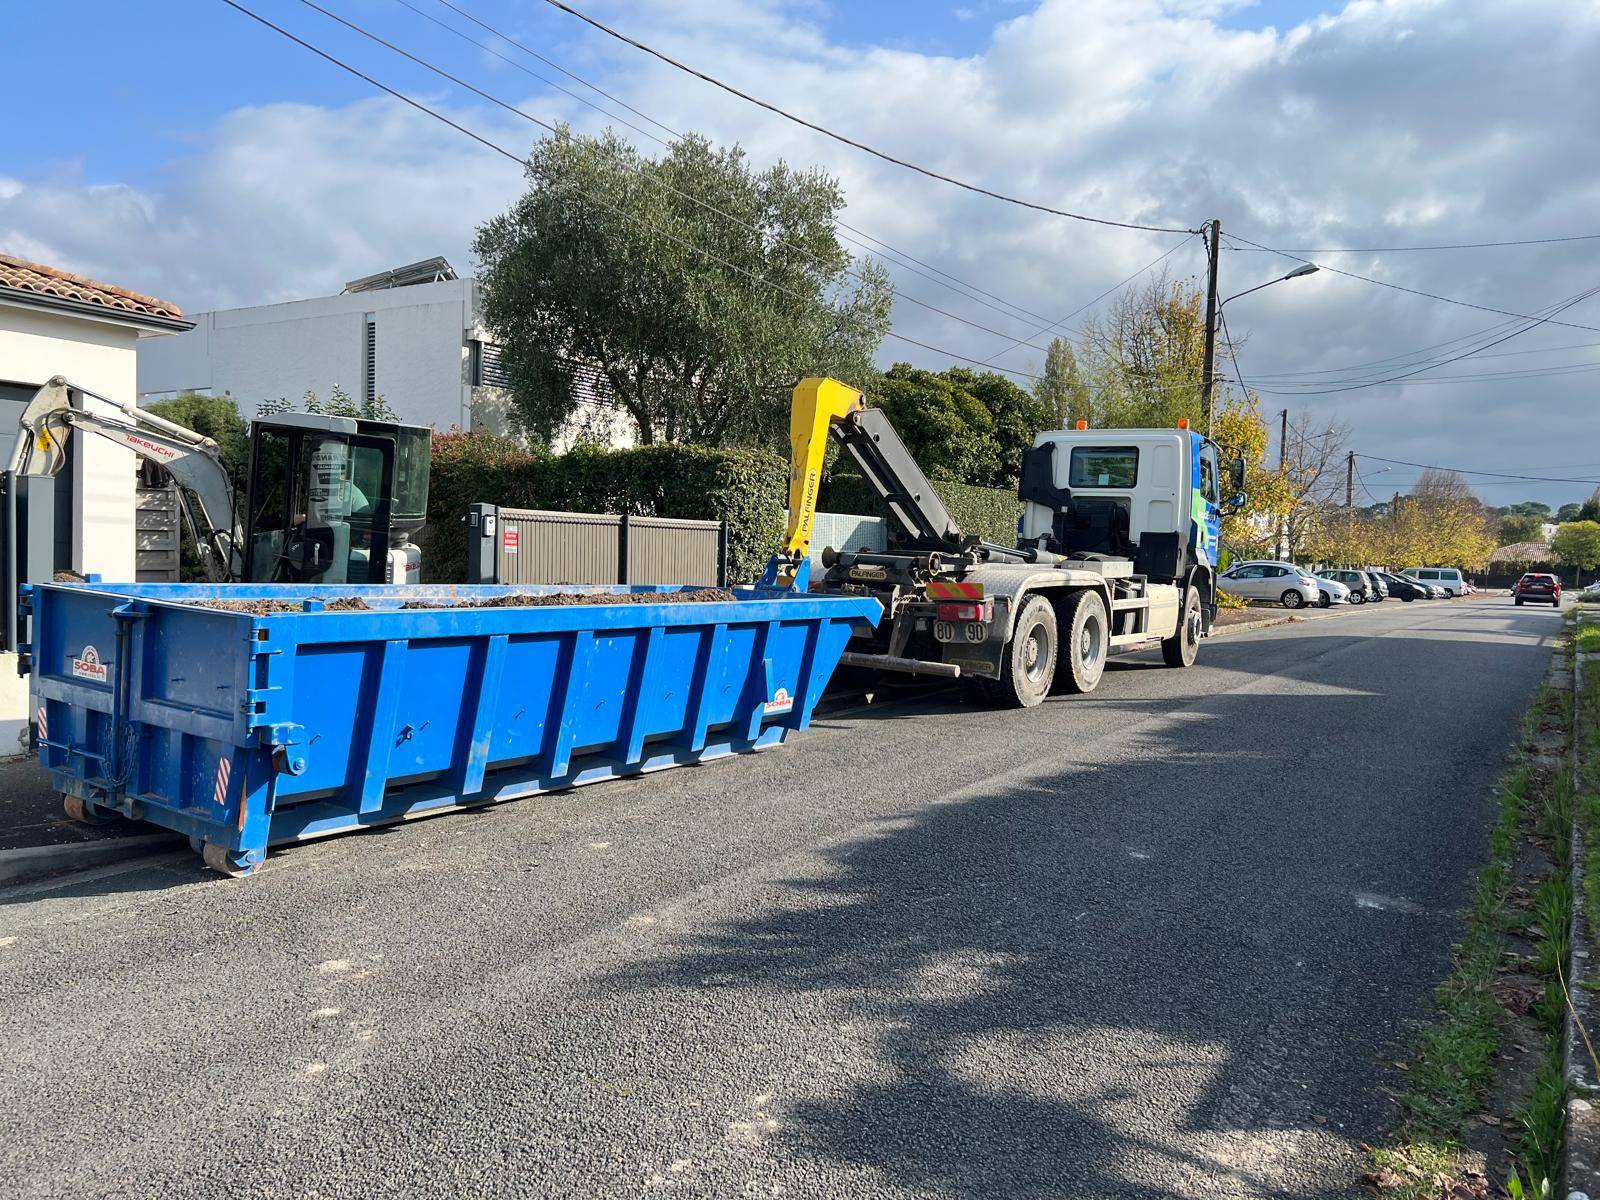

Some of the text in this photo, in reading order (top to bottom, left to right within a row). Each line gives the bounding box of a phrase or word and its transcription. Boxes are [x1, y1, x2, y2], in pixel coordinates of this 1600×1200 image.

[802, 472, 816, 532] PALFINGER
[937, 622, 952, 640] 80
[967, 623, 984, 641] 90
[74, 661, 105, 674] SOBA
